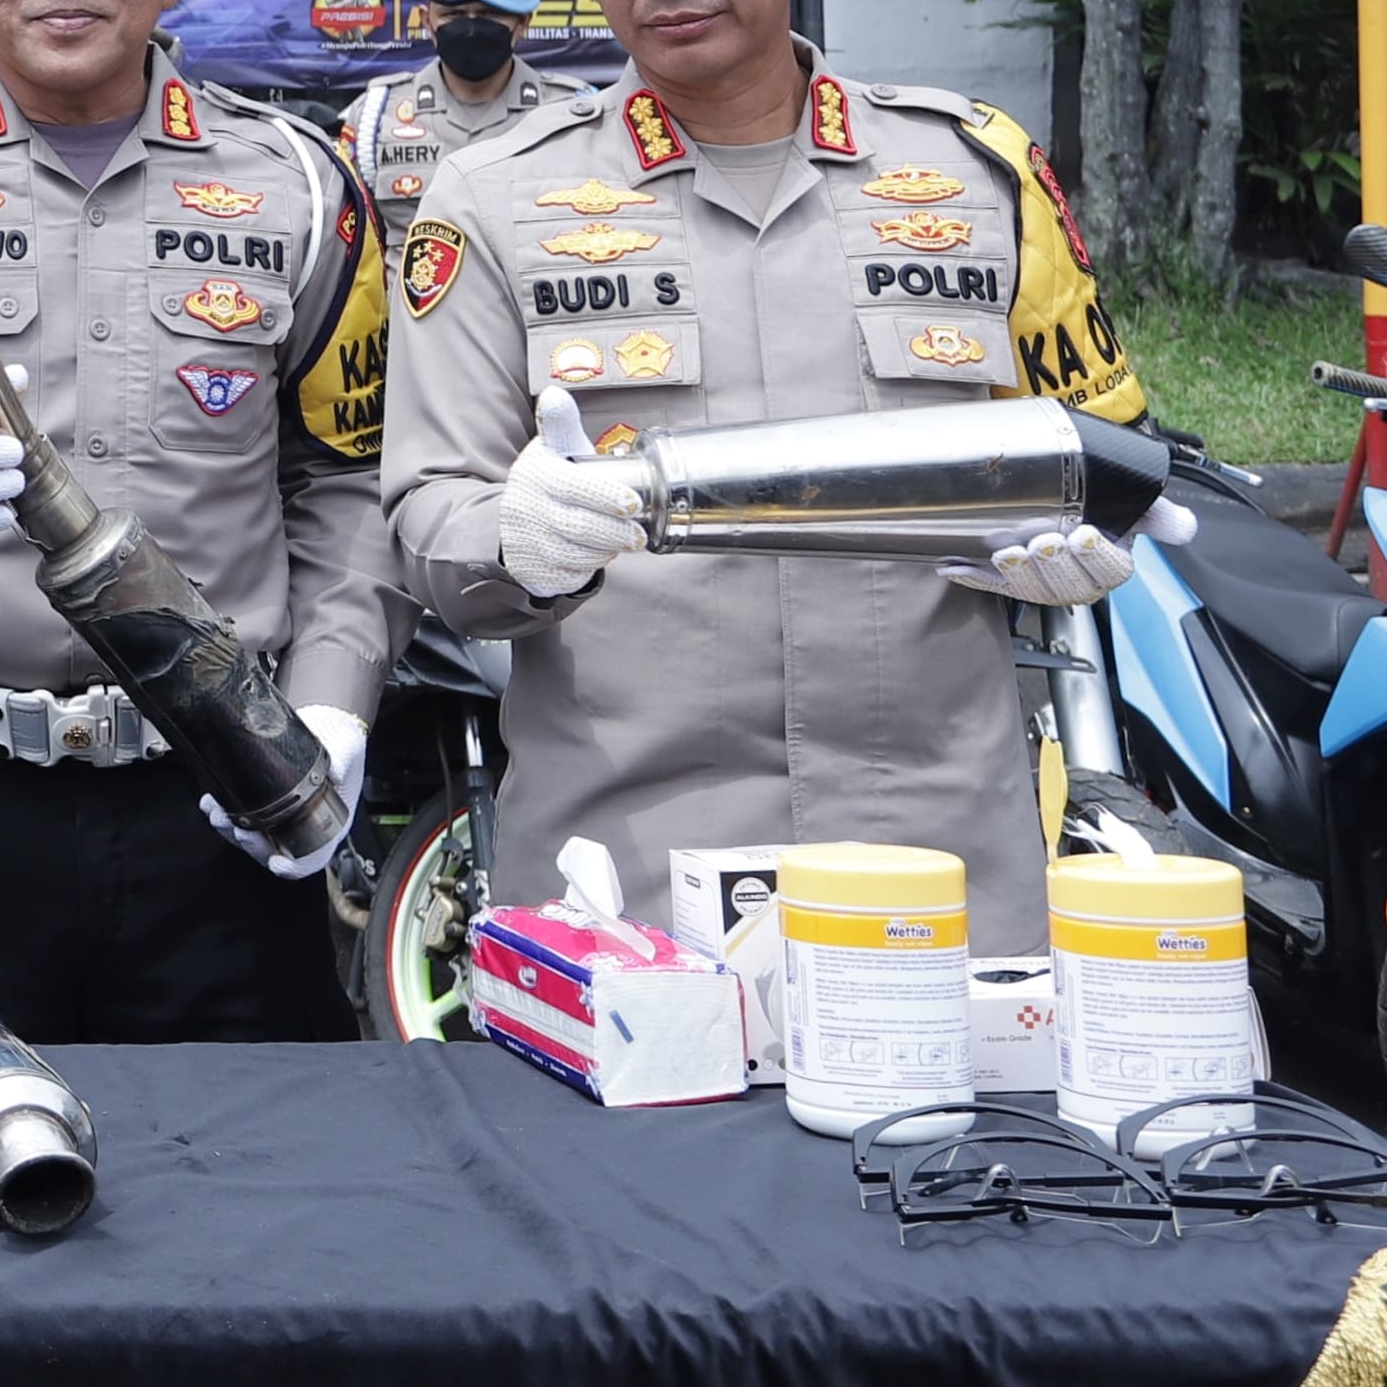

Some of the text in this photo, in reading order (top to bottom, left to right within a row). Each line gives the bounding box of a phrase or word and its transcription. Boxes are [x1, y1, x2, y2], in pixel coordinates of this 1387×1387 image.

[381, 143, 440, 165] A.HERY
[414, 221, 459, 243] RESKRIM
[155, 229, 285, 273] POLRI
[533, 271, 680, 315] BUDI S
[865, 263, 999, 303] POLRI
[1018, 323, 1089, 395] KA
[886, 925, 932, 938] Wetties
[1158, 937, 1206, 950] Wetties
